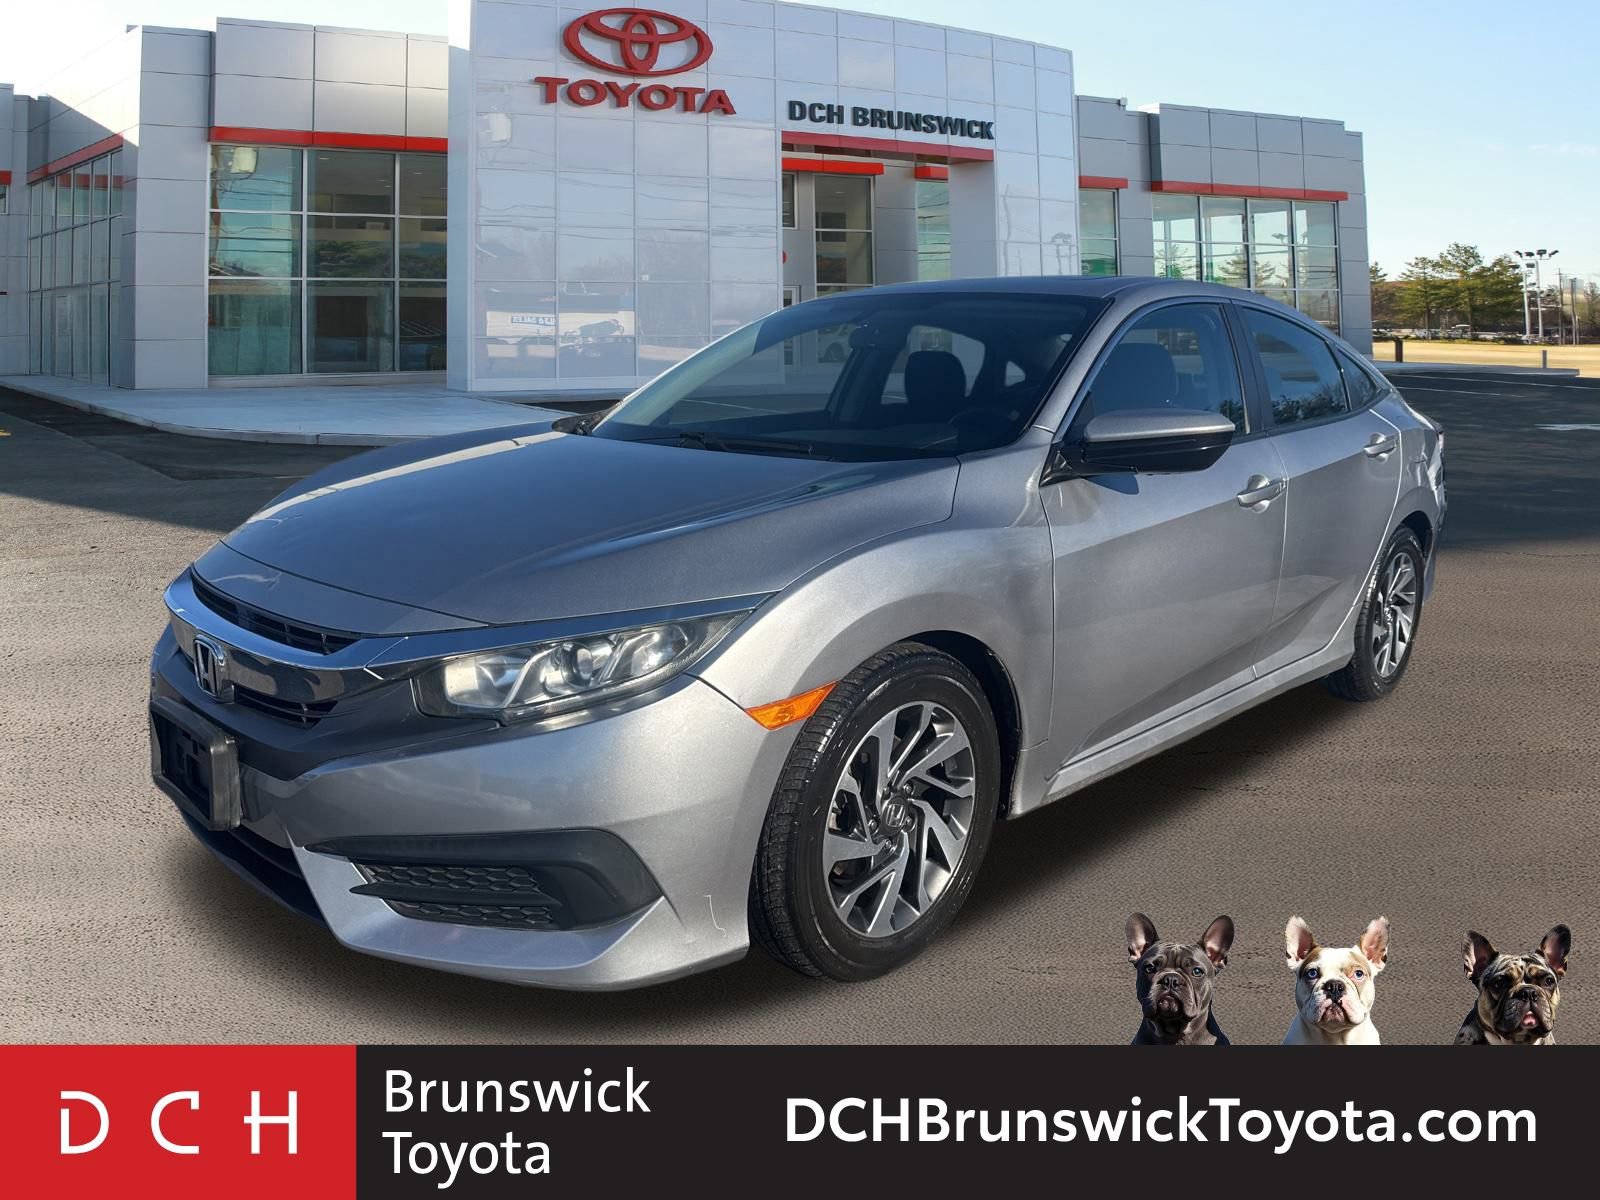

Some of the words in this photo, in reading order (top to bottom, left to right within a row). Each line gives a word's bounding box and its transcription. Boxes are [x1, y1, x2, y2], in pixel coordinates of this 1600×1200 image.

[534, 76, 737, 114] TOYOTA
[788, 100, 845, 125] DCH
[852, 106, 995, 140] BRUNSWICK
